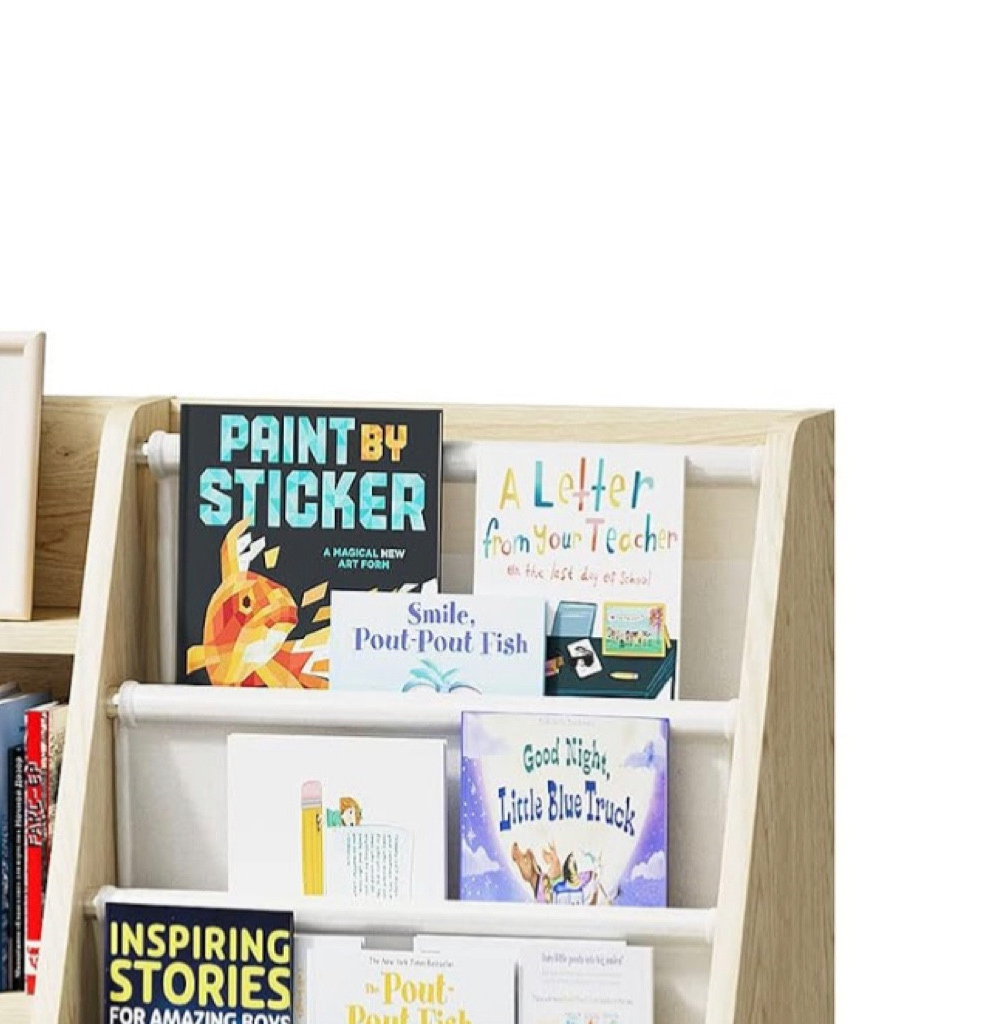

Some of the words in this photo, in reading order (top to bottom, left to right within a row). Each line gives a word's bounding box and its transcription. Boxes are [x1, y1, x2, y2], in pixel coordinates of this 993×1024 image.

[219, 413, 356, 466] PAINT
[360, 423, 408, 462] BY
[199, 467, 428, 531] STICKER
[499, 467, 521, 510] A
[534, 457, 655, 512] Letter
[323, 547, 331, 558] A
[332, 547, 379, 559] MAGICAL
[380, 548, 406, 560] NEW
[482, 517, 531, 559] from
[585, 512, 679, 556] Teacher
[337, 559, 359, 569] ART
[360, 560, 390, 570] FORM
[407, 600, 475, 628] Smile,
[353, 627, 475, 654] Pout-Pout
[480, 631, 528, 656] Fish
[523, 736, 560, 774] Good
[498, 786, 543, 832] Little
[547, 779, 583, 822] Blue
[585, 780, 636, 836] Truck
[109, 920, 291, 965] INSPIRING
[109, 957, 291, 1011] STORIES
